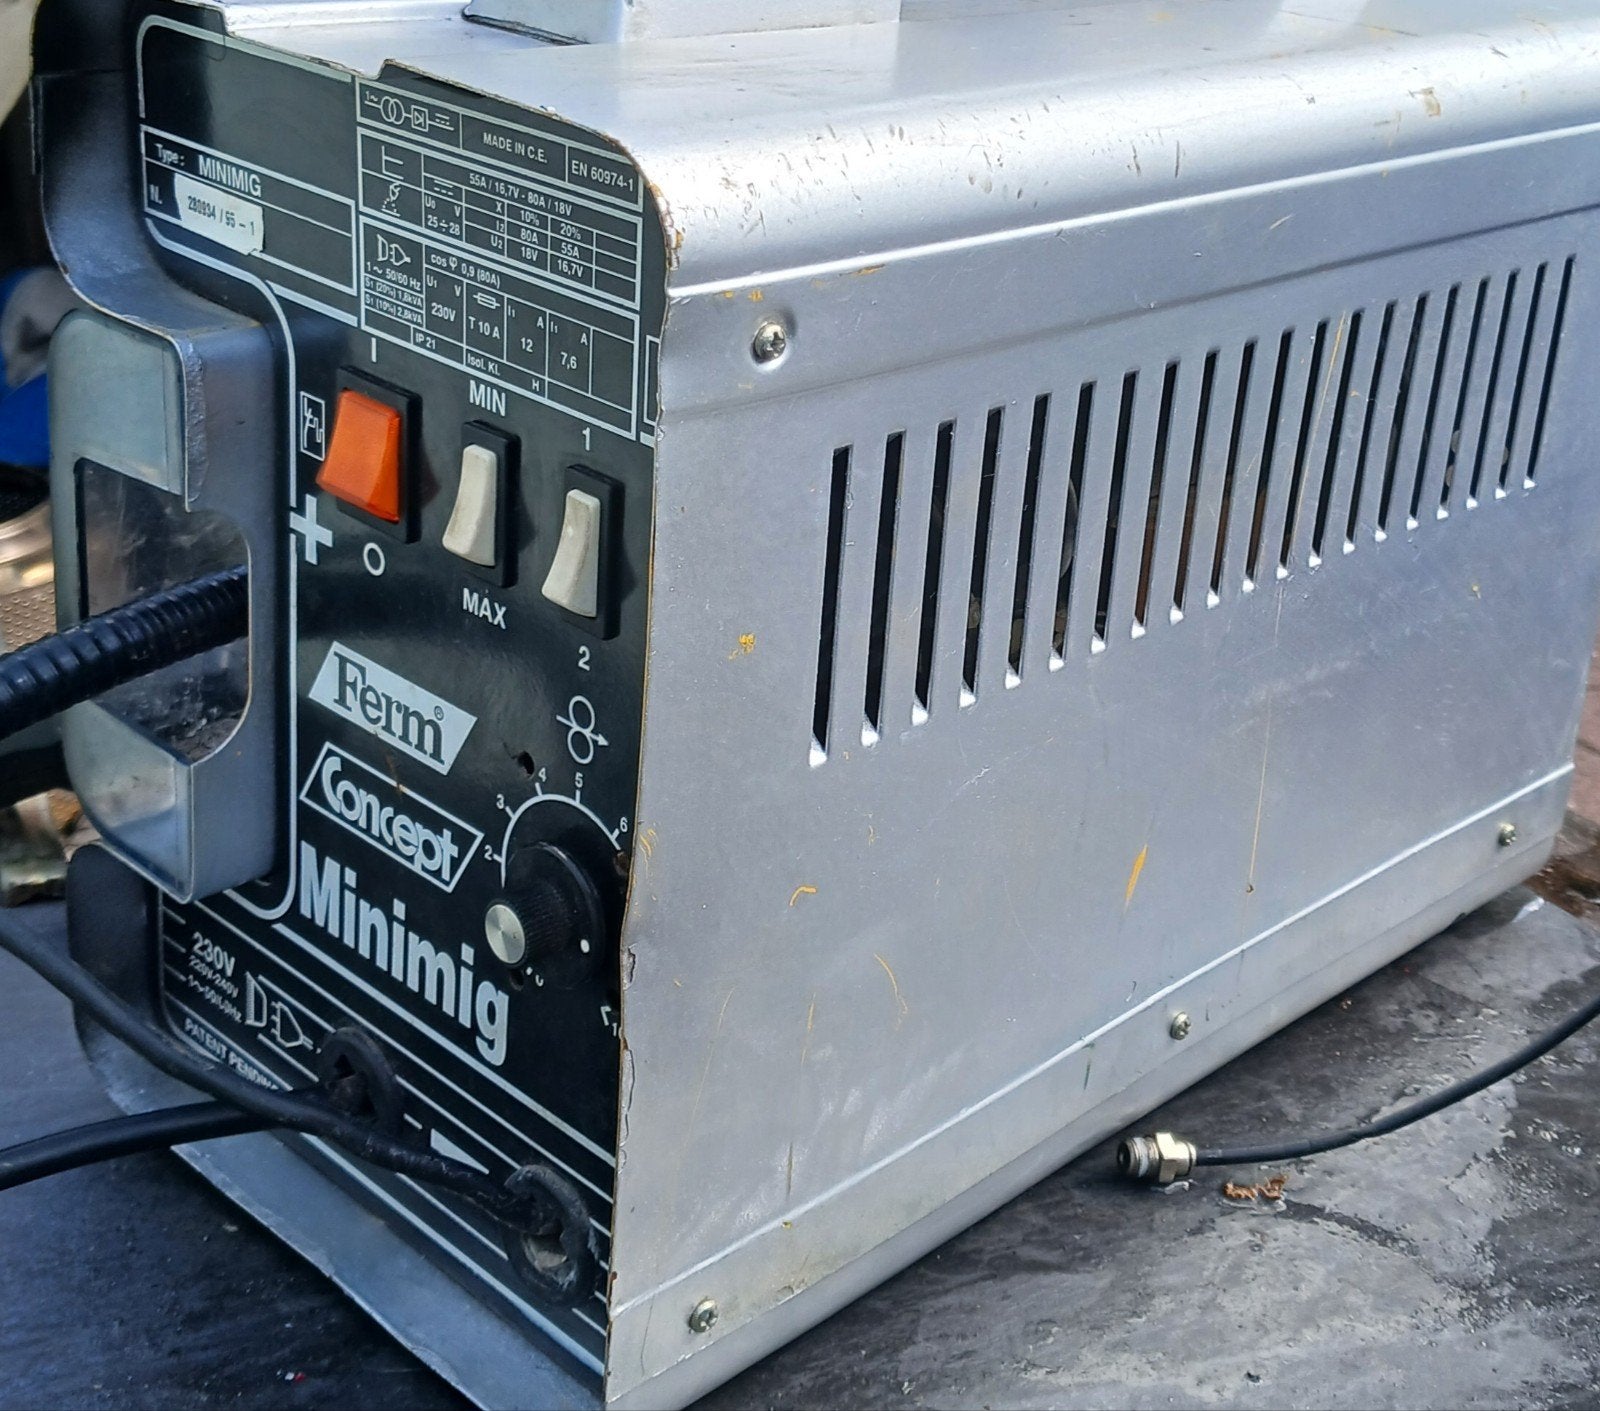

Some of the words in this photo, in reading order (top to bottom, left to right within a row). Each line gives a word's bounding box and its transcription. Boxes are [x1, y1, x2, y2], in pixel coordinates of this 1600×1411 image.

[483, 132, 512, 153] MADE
[515, 142, 526, 157] IN
[527, 146, 548, 164] C.E.
[199, 154, 262, 197] MINIMIG
[571, 160, 588, 178] EN
[590, 167, 634, 192] 60974-1
[469, 173, 487, 187] 55A
[494, 181, 520, 199] 16,7V
[527, 190, 546, 208] 80A
[554, 201, 572, 217] 18V
[454, 205, 461, 217] V
[496, 202, 503, 213] X
[520, 209, 540, 226] 10%
[560, 223, 581, 240] 20%
[520, 228, 539, 244] 80A
[560, 242, 580, 259] 55A
[430, 254, 447, 268] cos
[461, 263, 475, 278] 0,9
[477, 268, 501, 289] (80A)
[520, 246, 539, 261] 18V
[557, 259, 583, 278] 16,7V
[409, 277, 421, 291] Hz
[454, 284, 461, 297] V
[431, 302, 456, 322] 230V
[536, 316, 544, 329] A
[468, 316, 476, 330] T
[478, 321, 491, 336] 10
[492, 326, 501, 340] A
[580, 332, 588, 346] A
[415, 332, 425, 343] IP
[425, 336, 436, 350] 21
[520, 337, 533, 353] 12
[560, 351, 578, 370] 7,6
[532, 378, 540, 392] H
[469, 379, 507, 417] MIN
[581, 427, 591, 451] 1
[462, 587, 507, 630] MAX
[578, 645, 592, 671] 2
[538, 767, 547, 782] 4
[574, 772, 584, 788] 5
[496, 793, 505, 809] 3
[321, 756, 459, 882] Concept
[619, 817, 628, 833] 6
[484, 844, 494, 860] 2
[192, 931, 236, 977] 230V
[300, 840, 509, 1066] Minimig
[185, 1018, 227, 1060] PATENT
